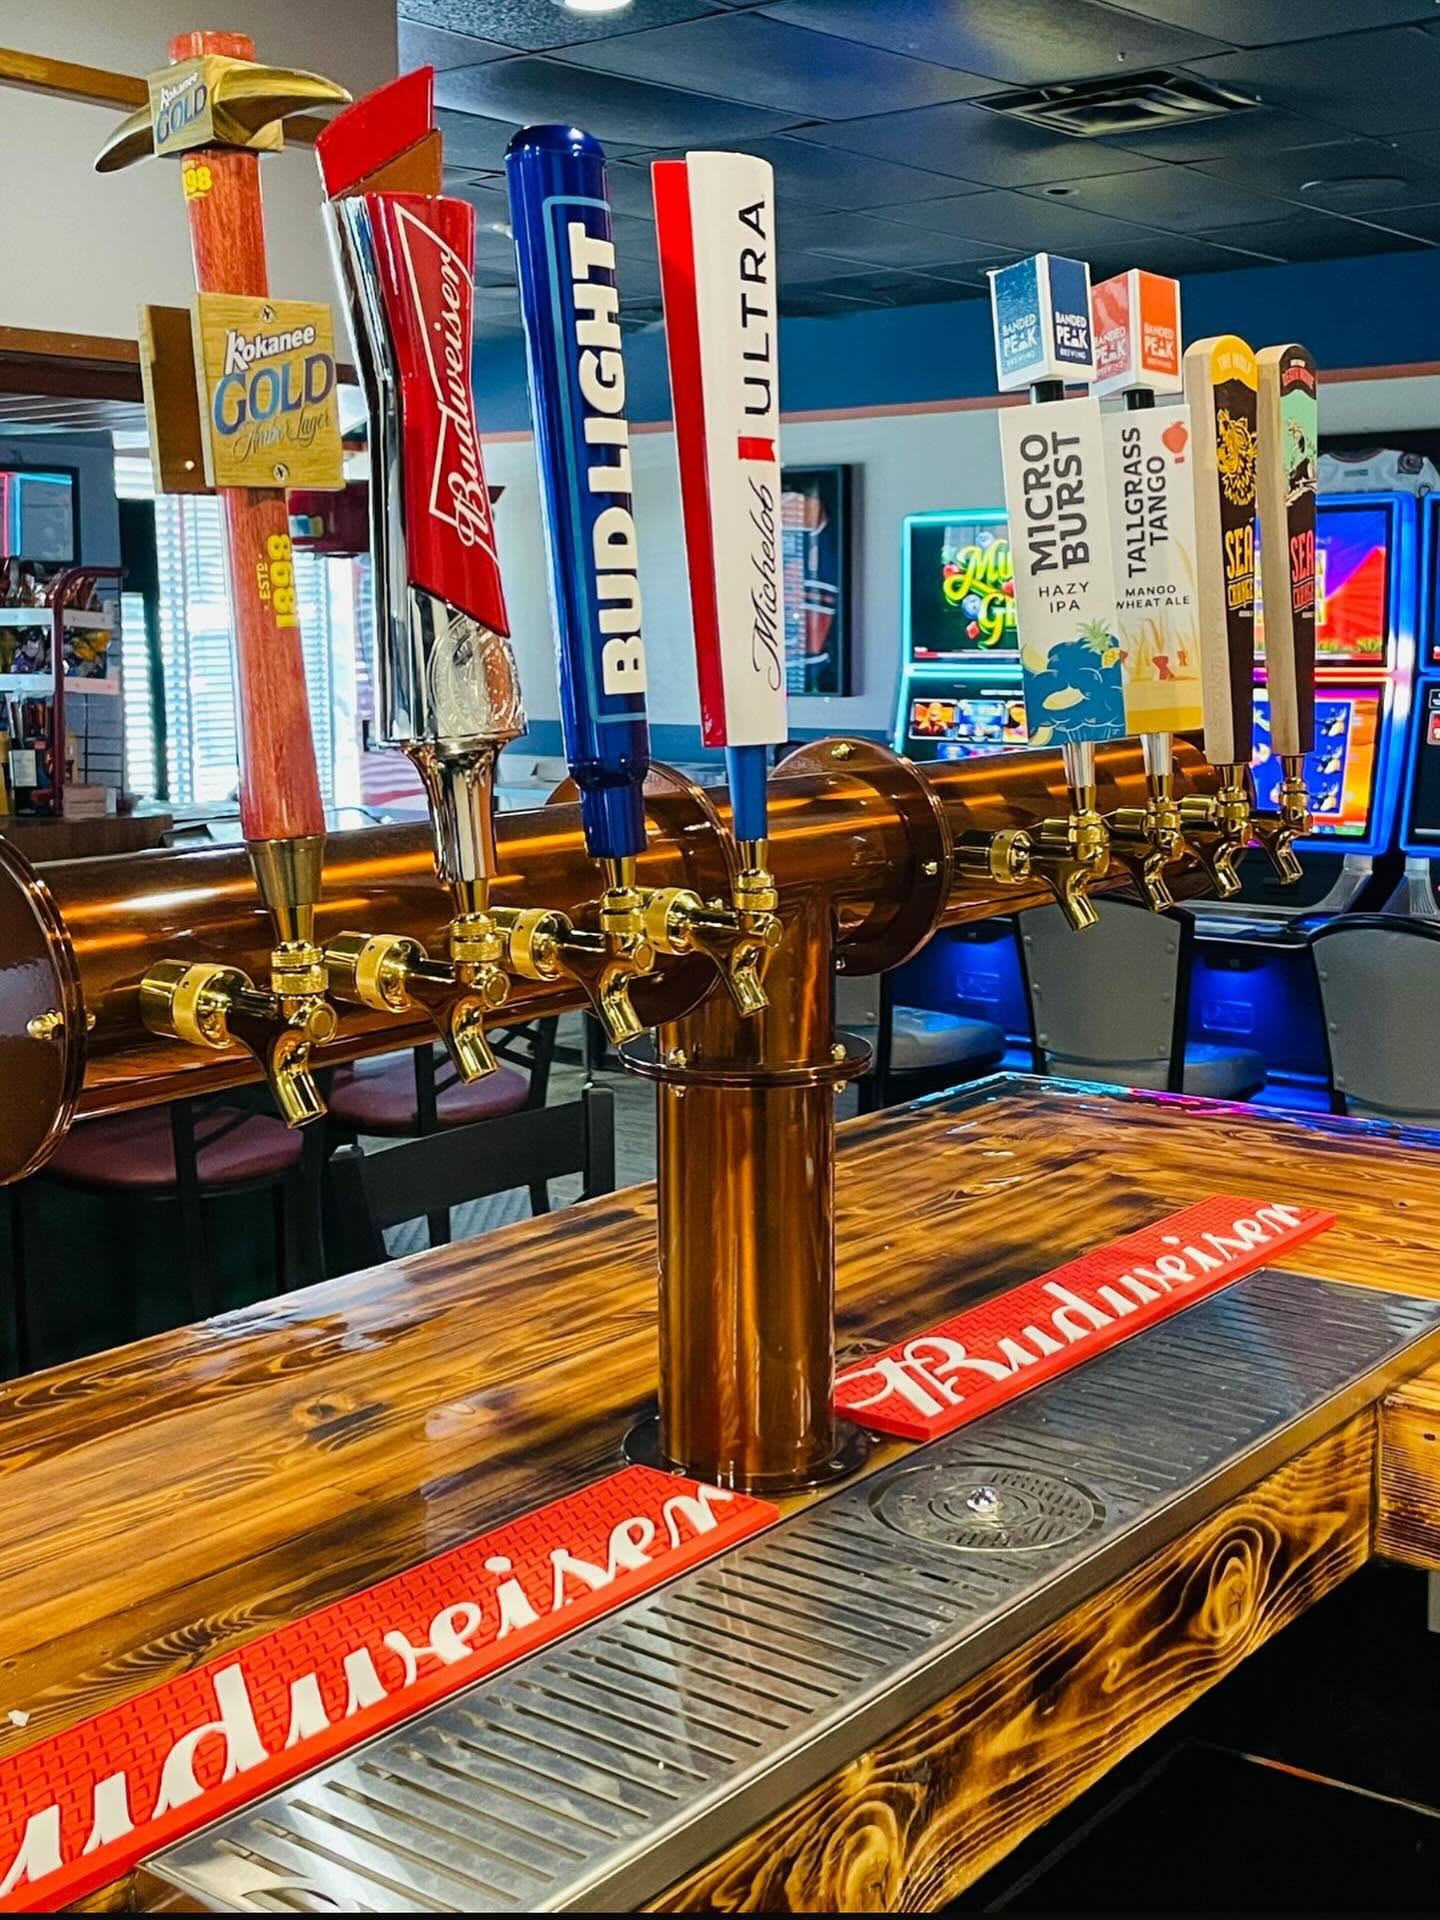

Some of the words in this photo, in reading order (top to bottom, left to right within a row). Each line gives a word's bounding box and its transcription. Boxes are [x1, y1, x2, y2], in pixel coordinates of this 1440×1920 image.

[156, 84, 207, 145] GOLD
[737, 198, 772, 417] ULTRA
[1002, 313, 1037, 338] BANDED
[1055, 311, 1087, 329] BANDED
[1144, 322, 1174, 339] BANDED
[225, 324, 316, 375] Kokanee
[568, 222, 631, 494] LIGHT
[1003, 325, 1039, 357] PEAK
[1056, 324, 1088, 350] PEAK
[1144, 336, 1175, 360] PEAK
[213, 353, 336, 436] GOLD
[436, 244, 499, 562] Budweiser
[288, 406, 331, 448] Lager
[1020, 434, 1059, 576] MICRO
[1051, 431, 1090, 569] BURST
[1121, 427, 1147, 578] TALLGRASS
[1146, 456, 1168, 546] TANGO
[1224, 524, 1254, 579] SEA
[1290, 529, 1315, 584] SEA
[267, 534, 298, 629] 1898
[594, 506, 645, 695] BUD
[748, 481, 784, 692] Michelob
[1039, 581, 1090, 597] HAZY
[1050, 600, 1081, 613] IPA
[1115, 597, 1162, 611] WHEAT
[1164, 595, 1191, 606] ALE
[1125, 584, 1177, 597] MANGO
[834, 1204, 1301, 1417] Budweiser
[0, 1484, 733, 1897] udweiser
